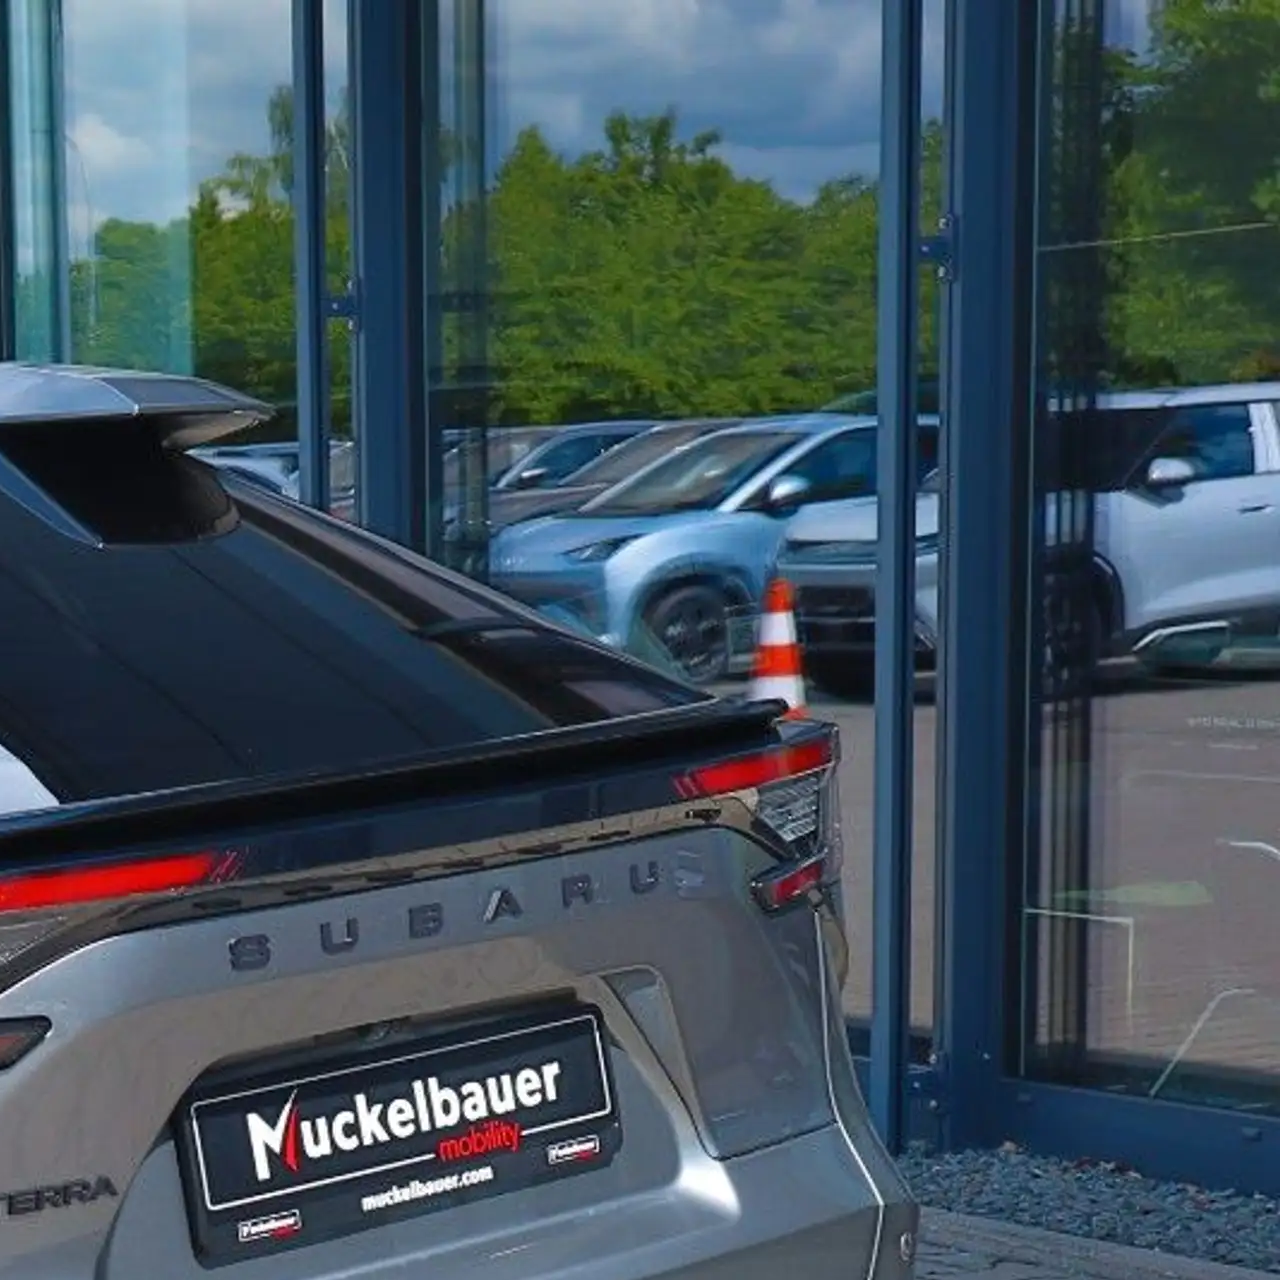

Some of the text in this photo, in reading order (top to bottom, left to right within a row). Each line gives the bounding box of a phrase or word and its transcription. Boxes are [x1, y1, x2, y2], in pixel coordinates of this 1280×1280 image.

[228, 849, 706, 971] SUBARU
[246, 1060, 561, 1181] Muckelbauer
[437, 1120, 523, 1162] mobility
[360, 1165, 494, 1213] muckelbauer.com
